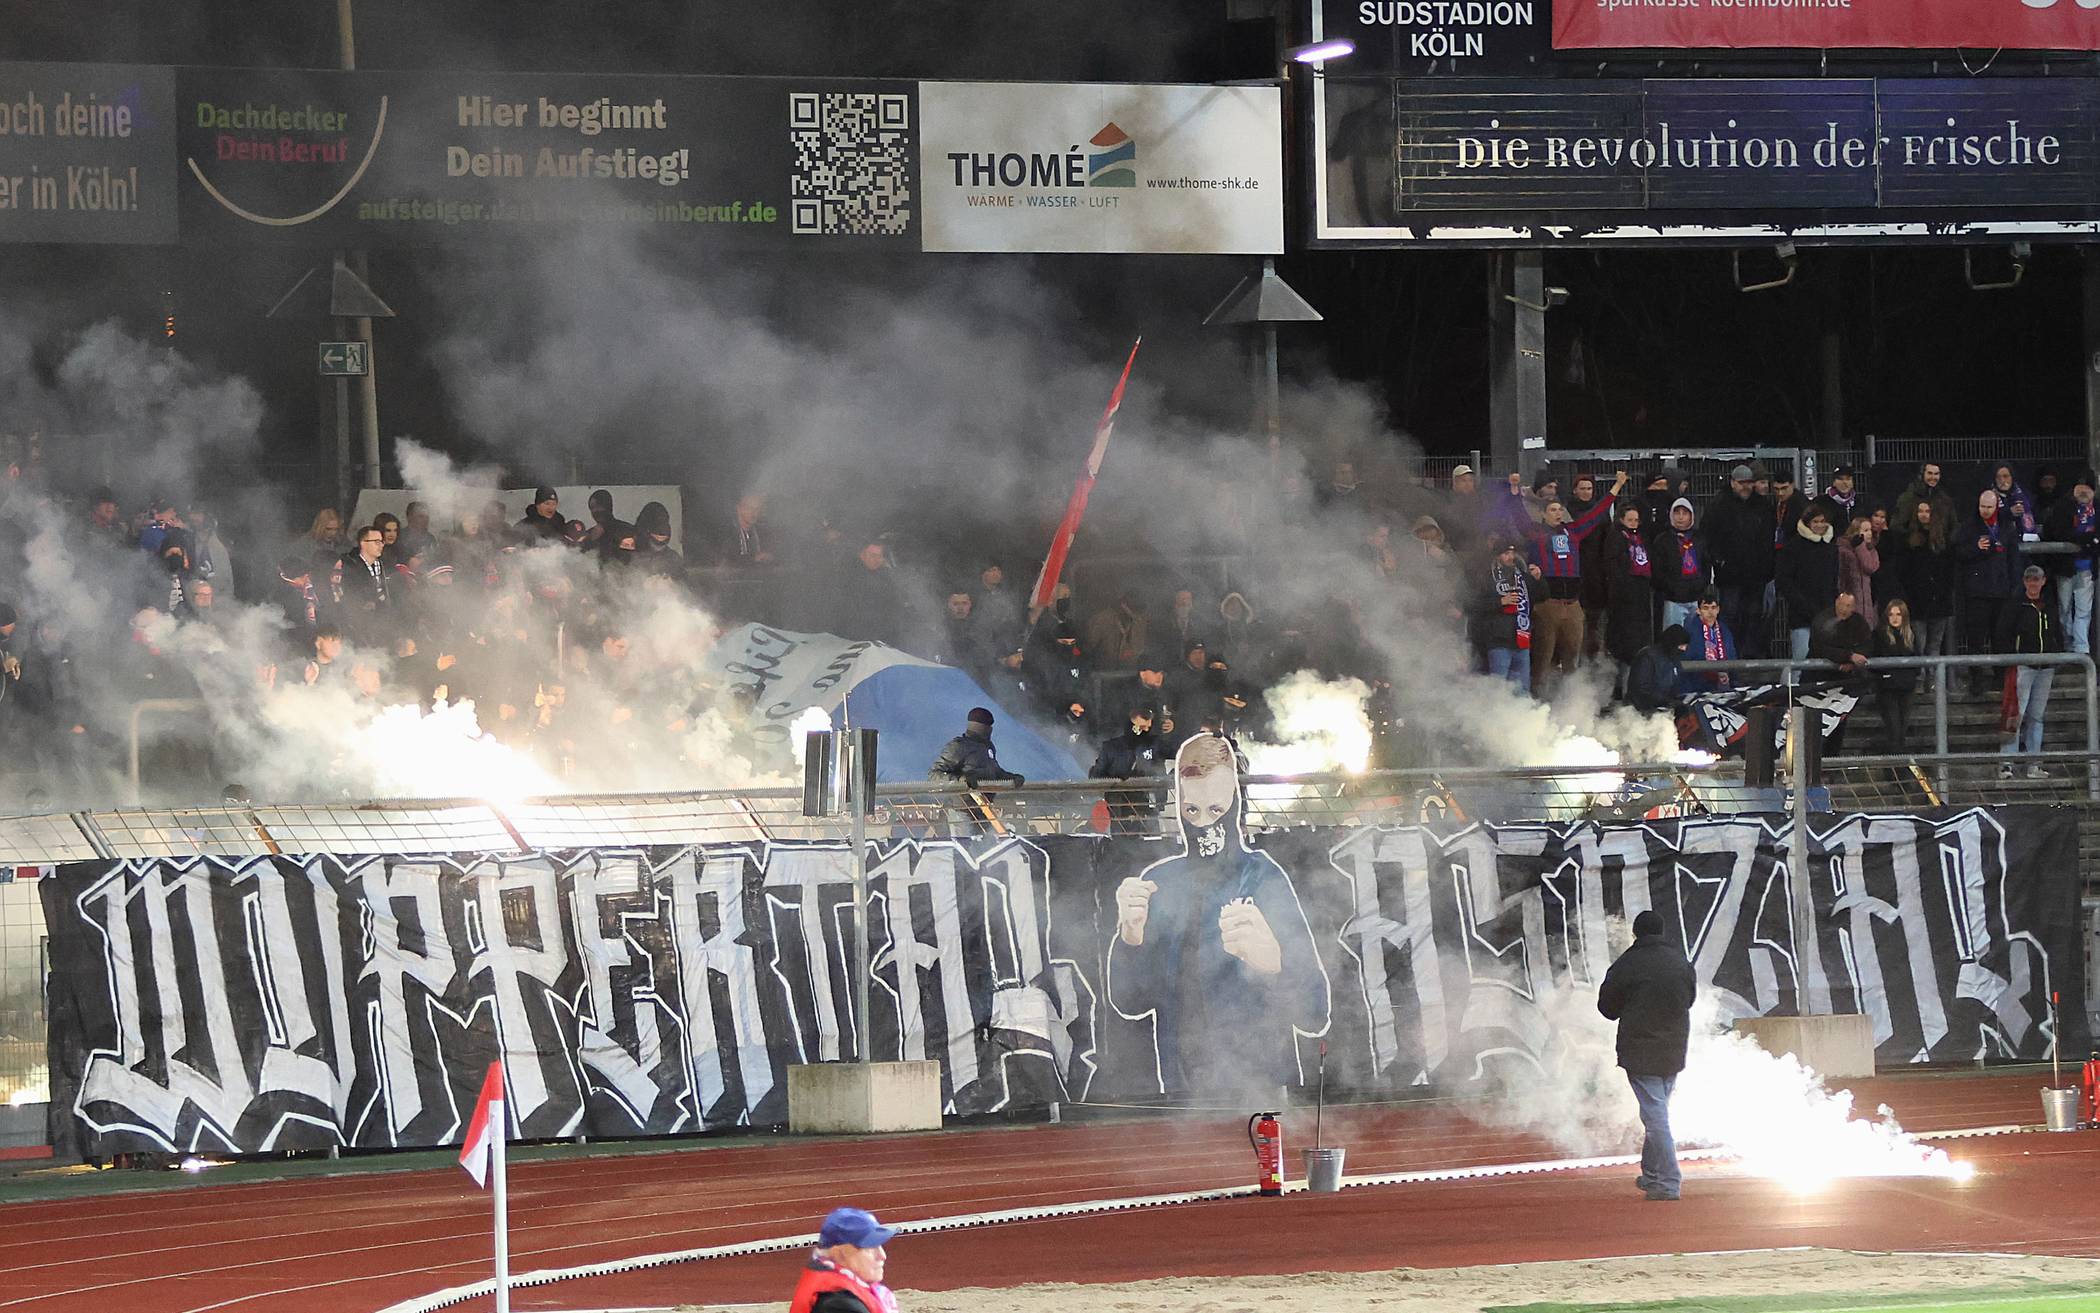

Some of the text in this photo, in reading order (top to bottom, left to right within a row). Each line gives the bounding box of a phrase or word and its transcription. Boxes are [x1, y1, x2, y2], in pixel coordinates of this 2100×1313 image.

[1411, 28, 1484, 57] KÖLN
[55, 92, 132, 138] deine
[197, 101, 348, 131] Dachdecker
[458, 96, 667, 135] Hier beginnt
[1456, 117, 2061, 168] Die Revolution der Frische
[447, 146, 689, 186] Dein Aufstieg!
[947, 145, 1085, 187] THOMÉ
[1147, 177, 1259, 190] www.thome-shk.de
[32, 165, 57, 210] in
[66, 165, 138, 211] Köln!
[1026, 195, 1077, 208] WASSER
[1089, 195, 1119, 208] LUFT
[74, 842, 1097, 1154] WUPPERTAL
